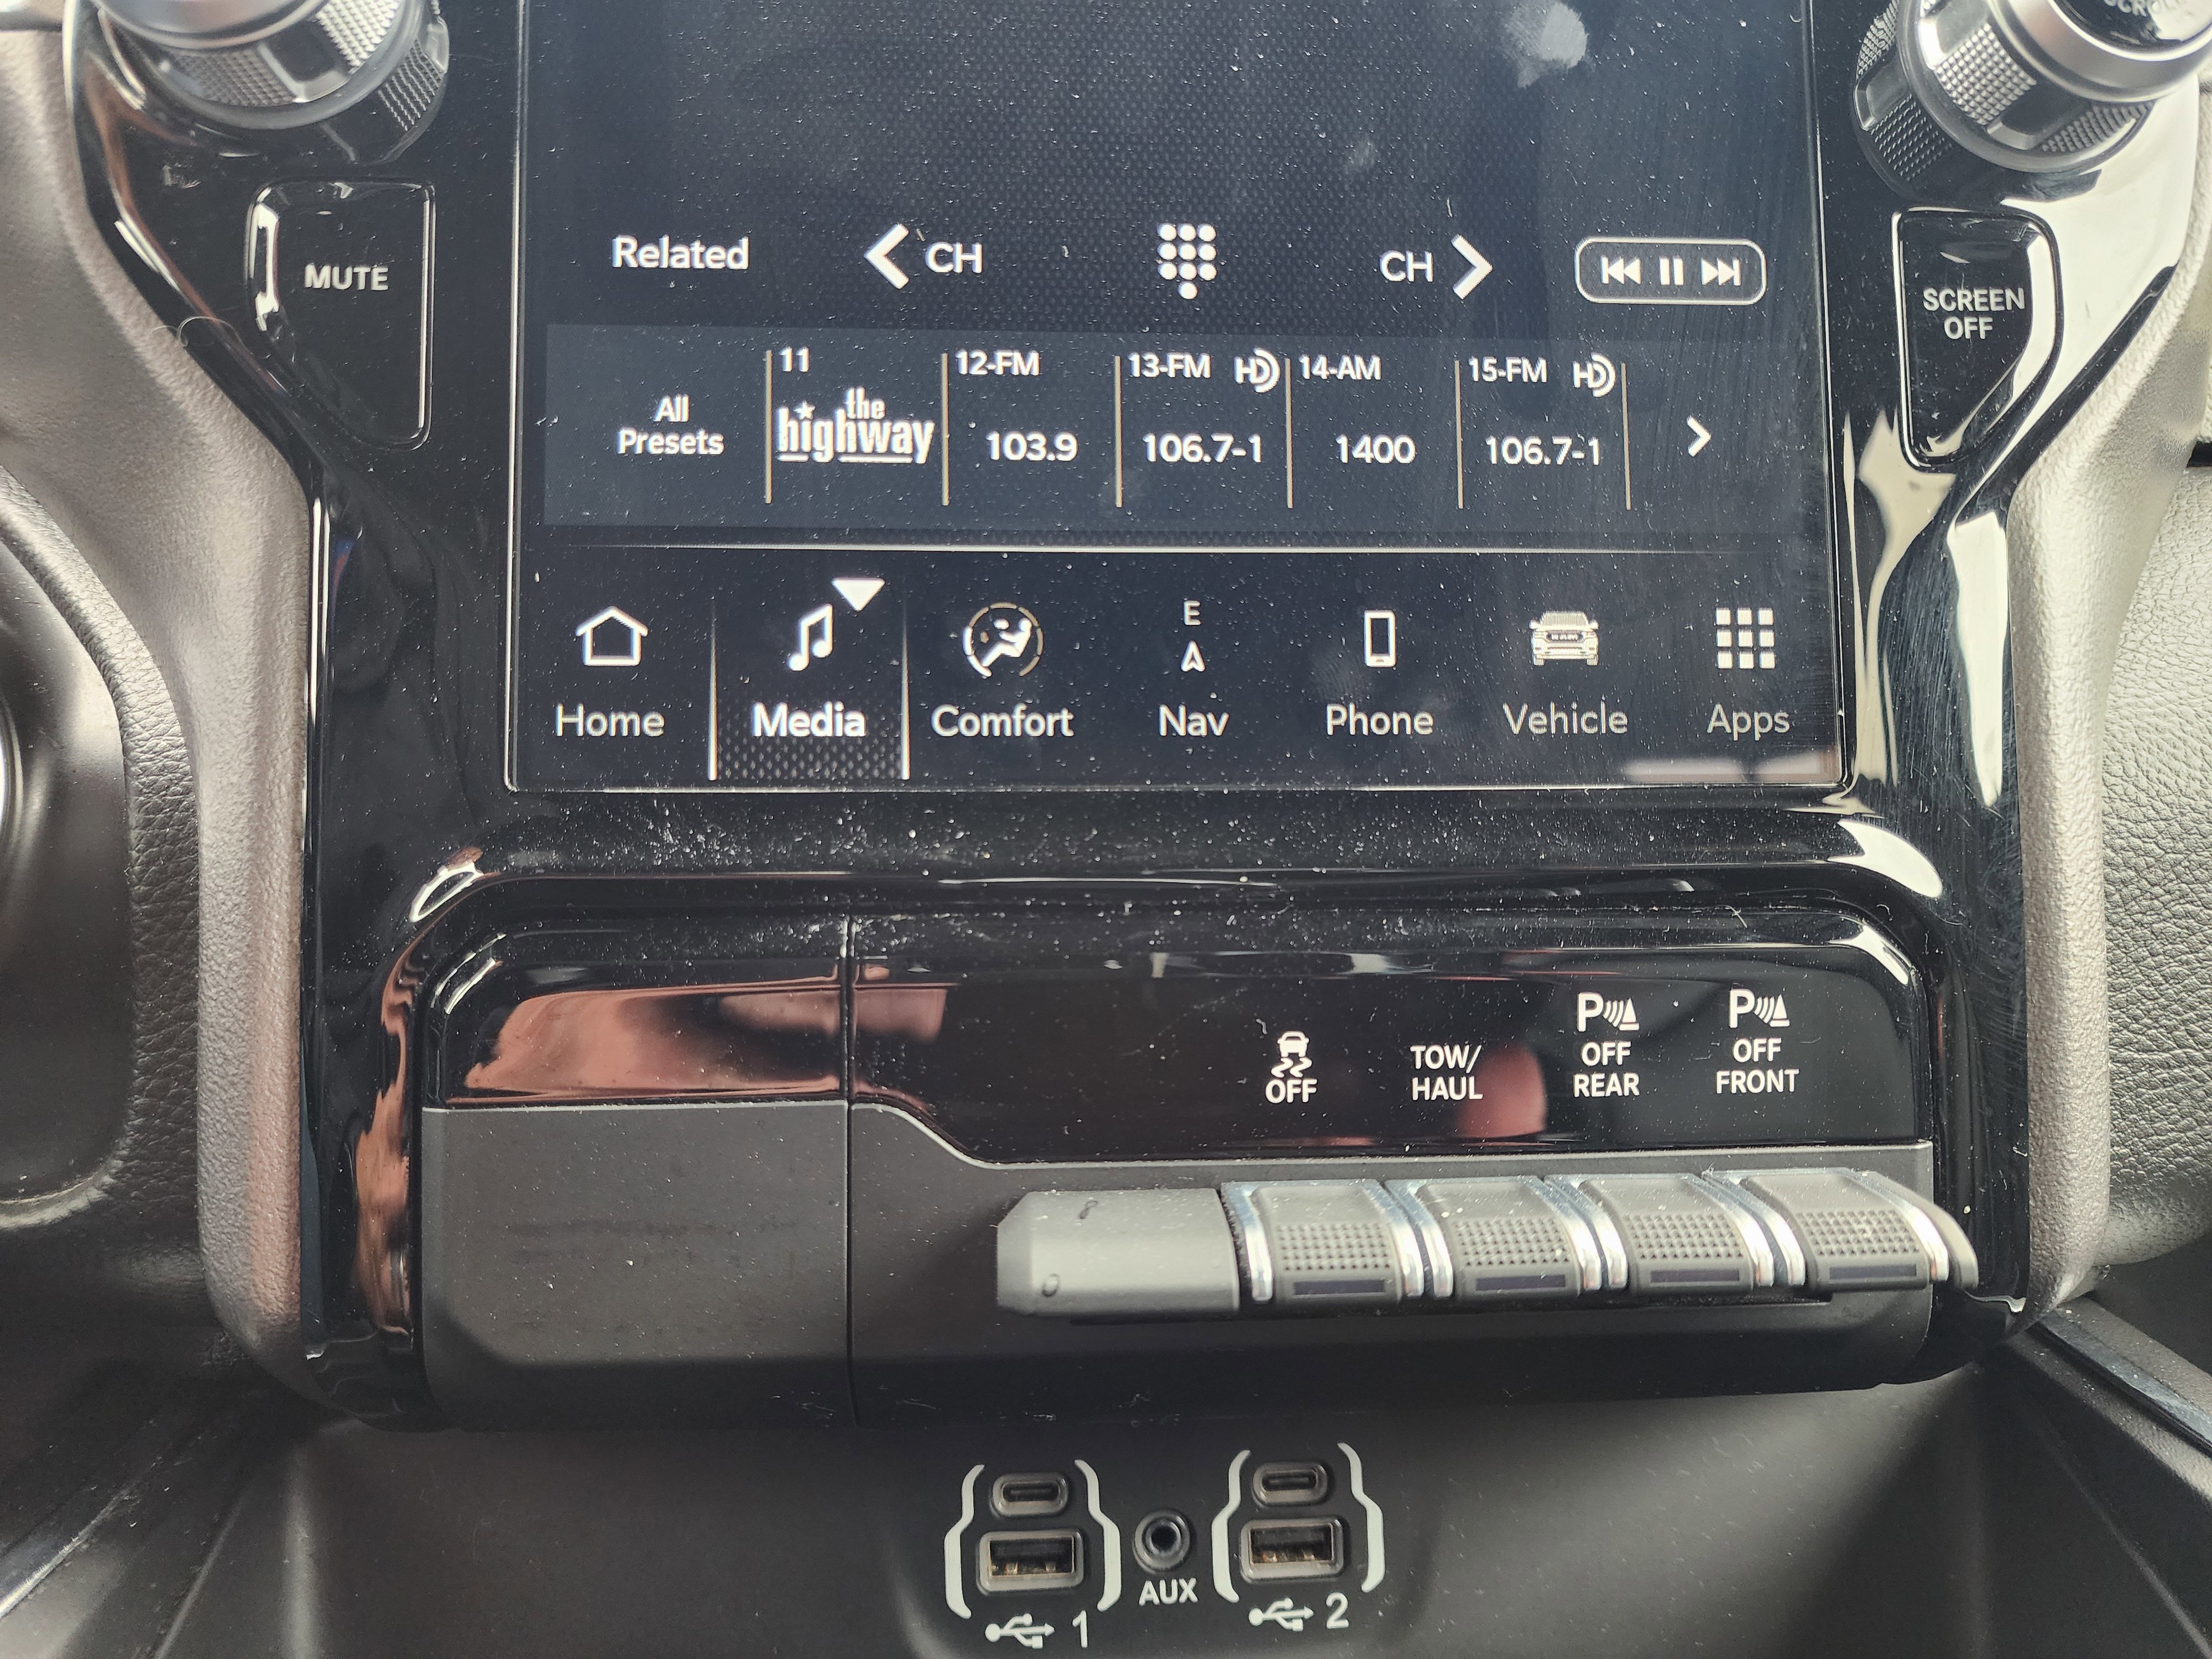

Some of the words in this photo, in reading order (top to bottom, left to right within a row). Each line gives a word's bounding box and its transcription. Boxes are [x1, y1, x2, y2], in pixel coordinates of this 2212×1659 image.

[612, 234, 749, 270] Related
[925, 241, 983, 274] CH
[1379, 250, 1434, 283] CH
[304, 263, 389, 291] MUTE
[1922, 286, 2026, 312] SCREEN
[1943, 316, 1994, 340] OFF
[779, 346, 810, 373] 11
[955, 349, 1040, 377] 12-FM
[1128, 352, 1211, 379] 13-FM
[1234, 347, 1281, 393] HD
[1298, 354, 1382, 380] 14-AM
[1468, 356, 1548, 383] 15-FM
[1572, 352, 1616, 398] HD
[653, 394, 690, 422] All
[844, 387, 886, 420] the
[617, 427, 725, 455] Presets
[776, 406, 936, 465] highway
[985, 431, 1078, 462] 103.9
[1142, 432, 1262, 463] 106.7-1
[1335, 434, 1416, 464] 1400
[1485, 435, 1600, 466] 106.7-1
[1183, 600, 1202, 626] E
[556, 703, 665, 738] Home
[753, 701, 867, 738] Media
[932, 703, 1074, 737] Comfort
[1159, 704, 1230, 737] Nav
[1326, 702, 1434, 736] Phone
[1502, 700, 1629, 735] Vehicle
[1706, 702, 1791, 742] Apps
[1410, 1044, 1482, 1073] TOW/
[1581, 1040, 1632, 1067] OFF
[1733, 1037, 1782, 1063] OFF
[1265, 1077, 1318, 1104] OFF
[1412, 1075, 1484, 1101] HAUL
[1573, 1072, 1640, 1098] REAR
[1716, 1068, 1800, 1094] FRONT
[1138, 1578, 1199, 1605] AUX
[1325, 1592, 1350, 1630] 2
[1071, 1609, 1088, 1648] 1
